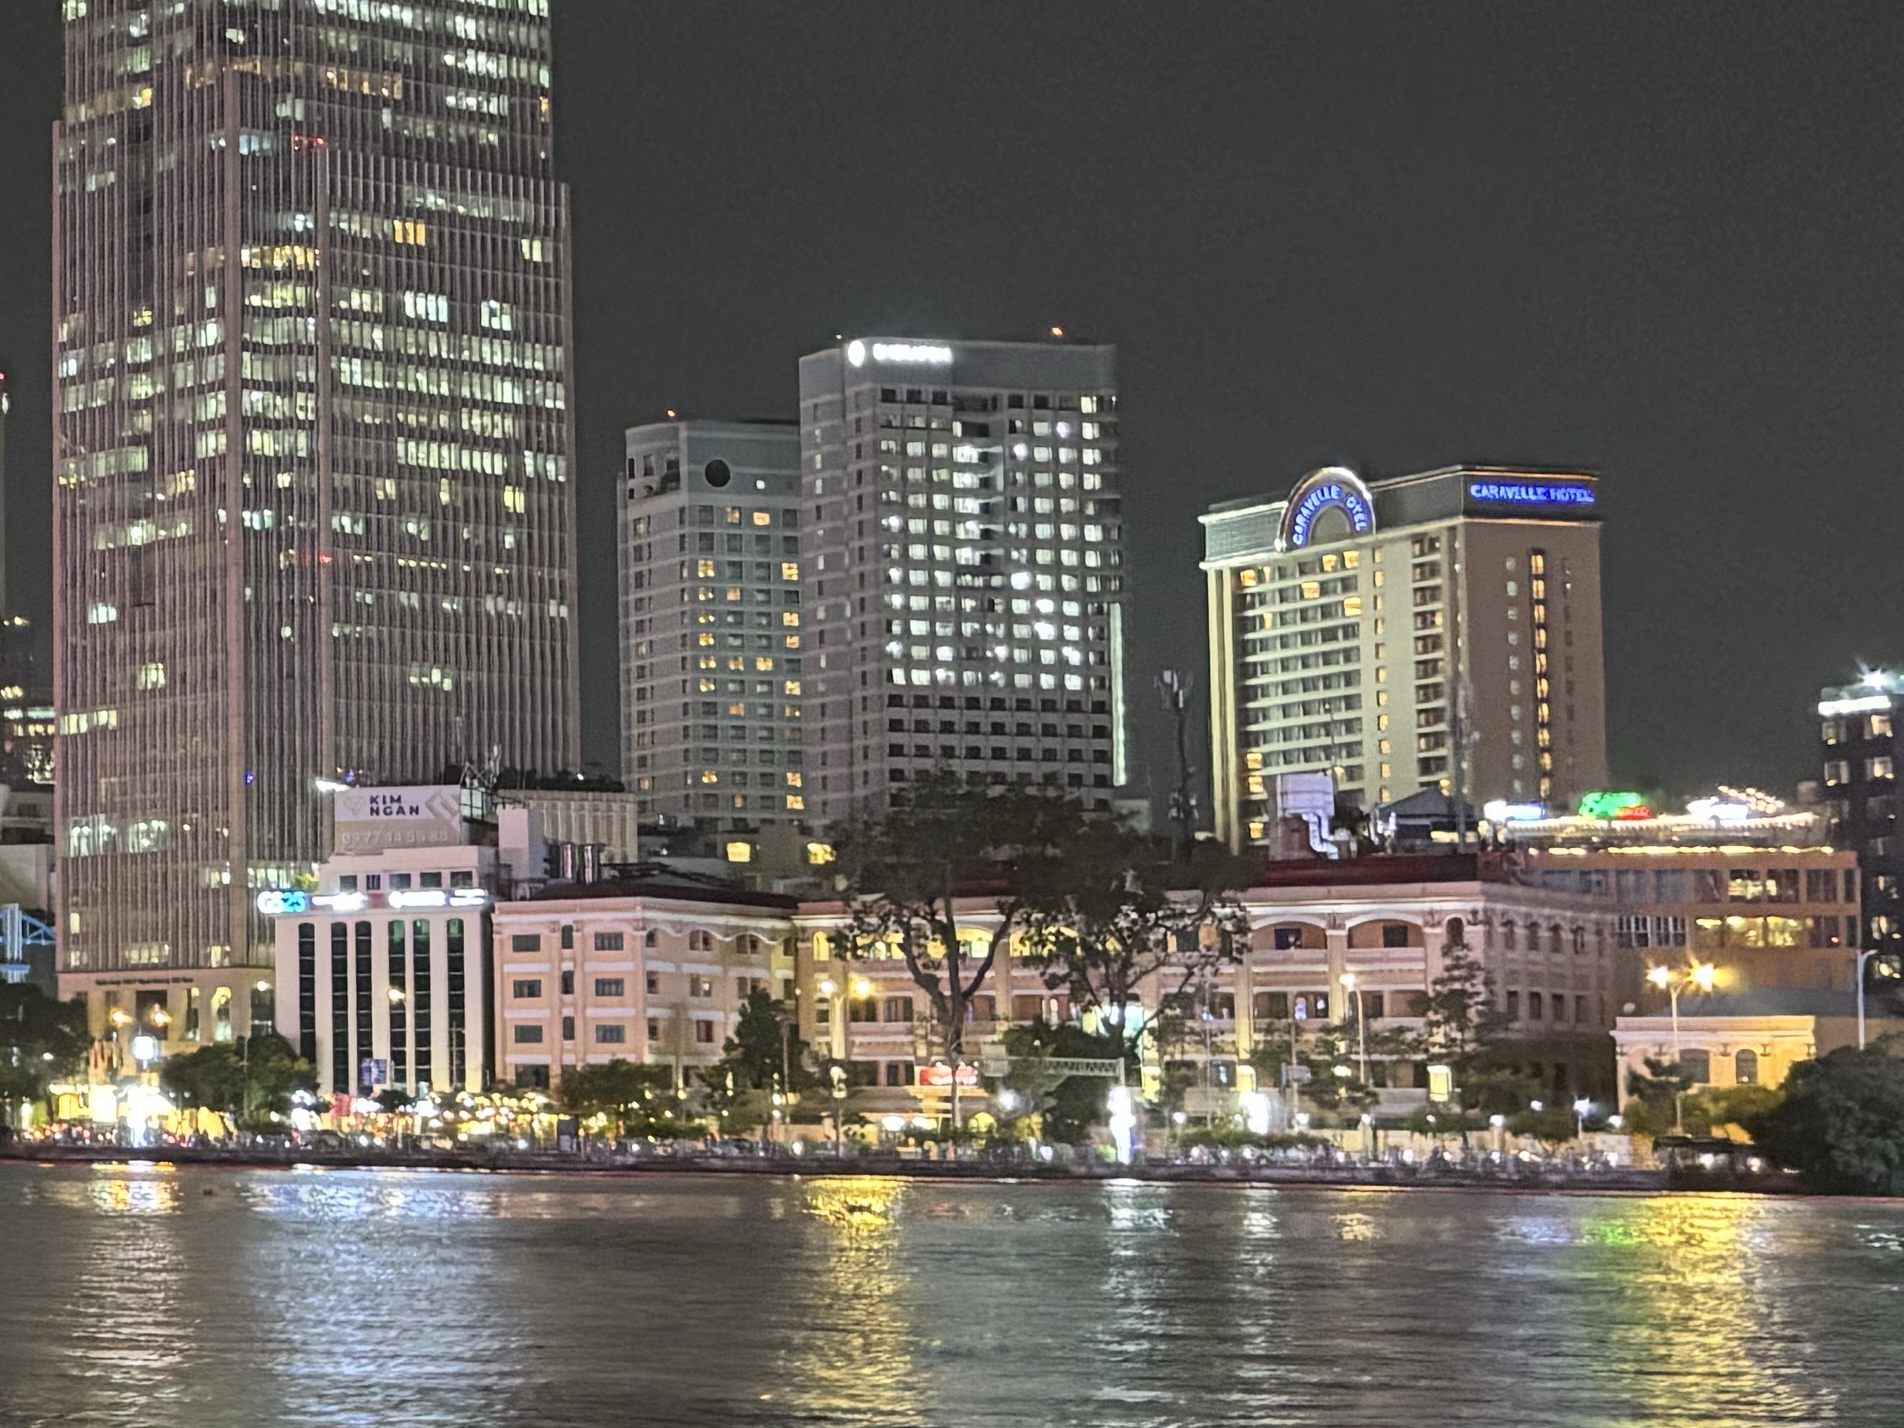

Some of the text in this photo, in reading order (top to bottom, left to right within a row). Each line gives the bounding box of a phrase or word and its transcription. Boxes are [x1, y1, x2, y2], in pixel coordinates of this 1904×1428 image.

[1470, 484, 1595, 503] CARAVELLE HOTEL
[1292, 484, 1341, 546] CARAVELLE
[370, 794, 402, 805] KIM
[258, 891, 309, 914] GS25
